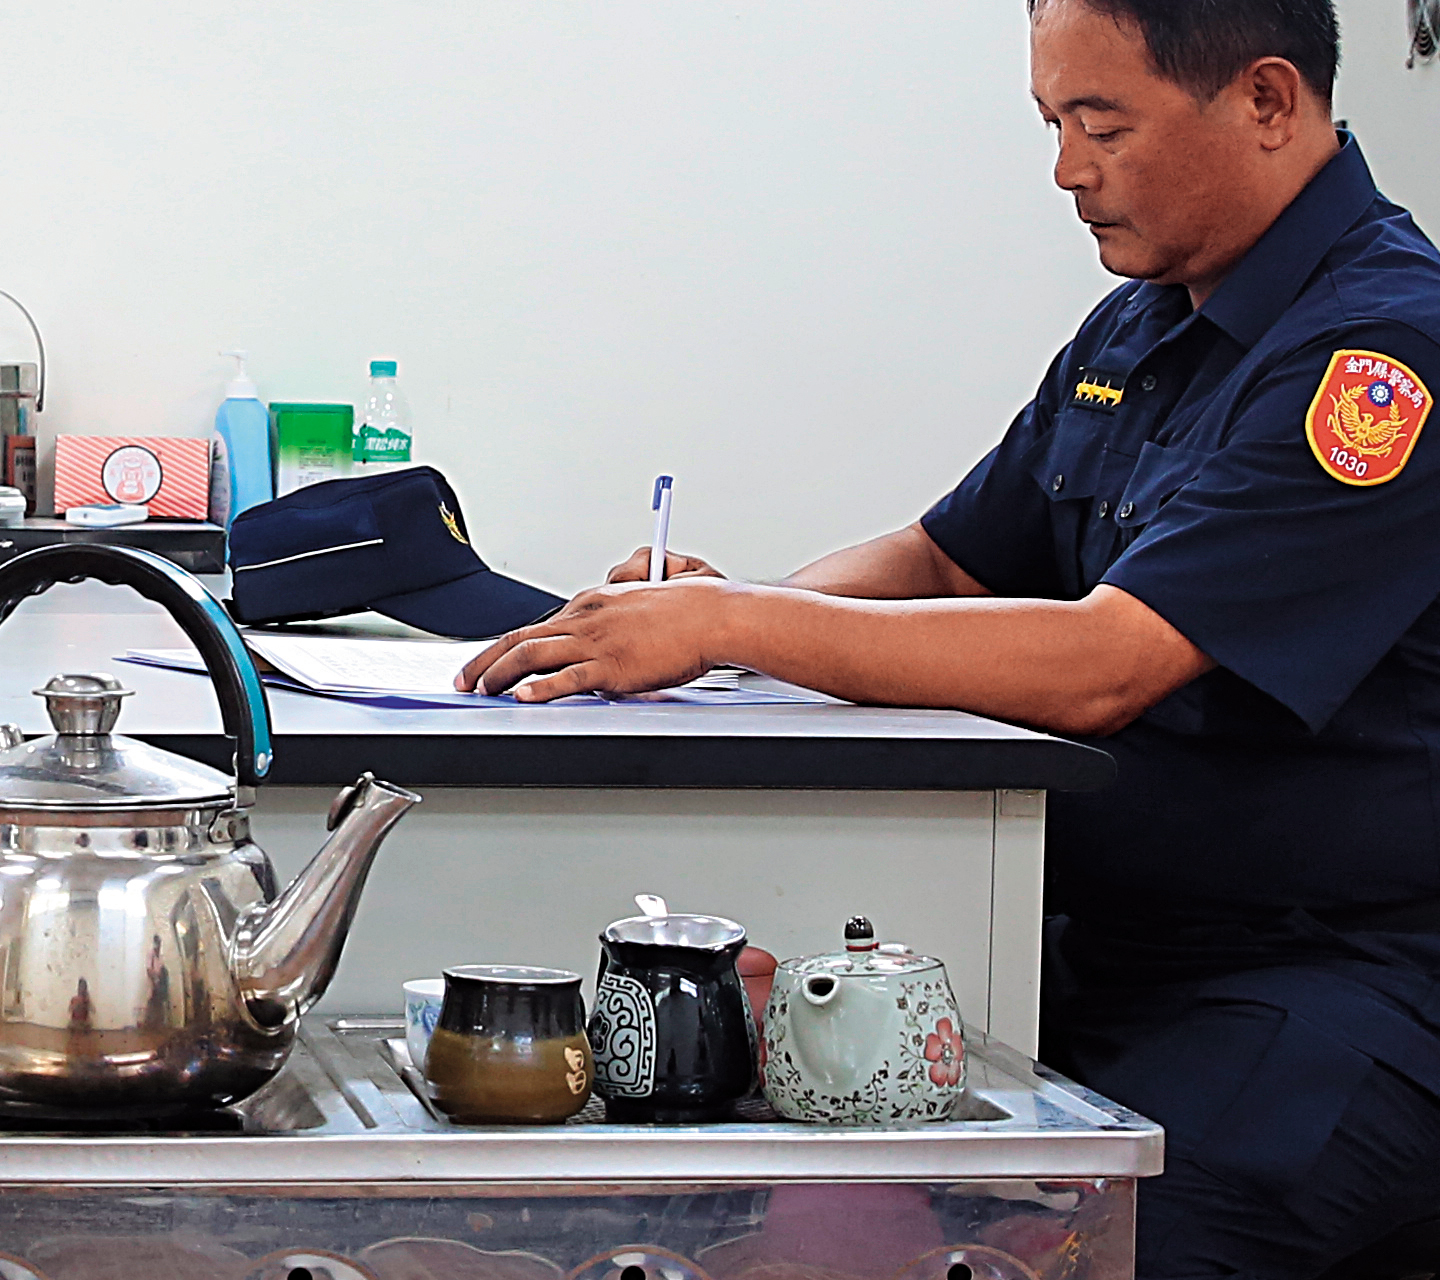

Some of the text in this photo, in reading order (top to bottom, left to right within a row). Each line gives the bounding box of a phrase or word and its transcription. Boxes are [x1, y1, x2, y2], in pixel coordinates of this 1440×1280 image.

[1345, 356, 1424, 408] 金門縣警察局
[1329, 447, 1368, 477] 1030
